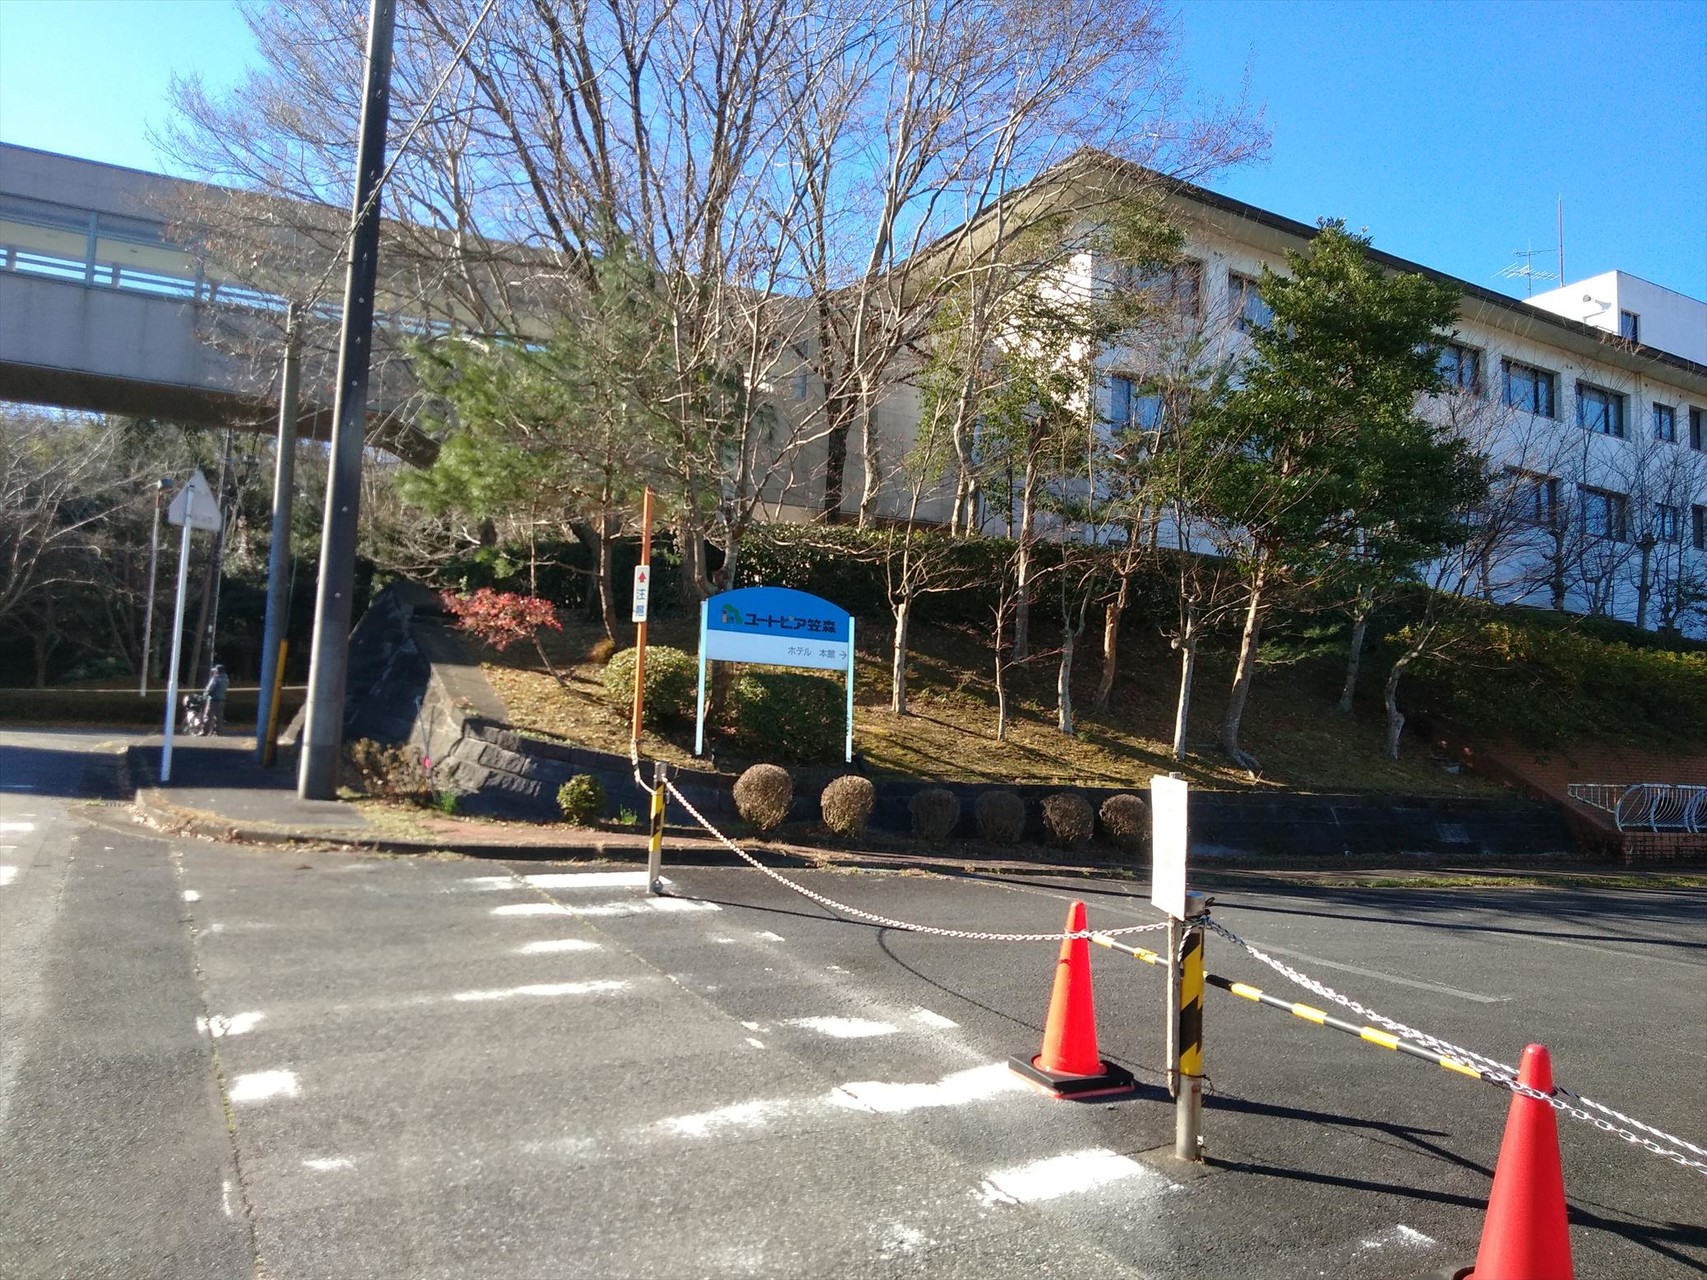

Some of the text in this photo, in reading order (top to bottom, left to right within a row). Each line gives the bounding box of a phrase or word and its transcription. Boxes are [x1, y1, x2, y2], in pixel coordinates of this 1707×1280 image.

[744, 613, 837, 634] ユートピア笠森
[787, 646, 836, 659] ホテル 本館
